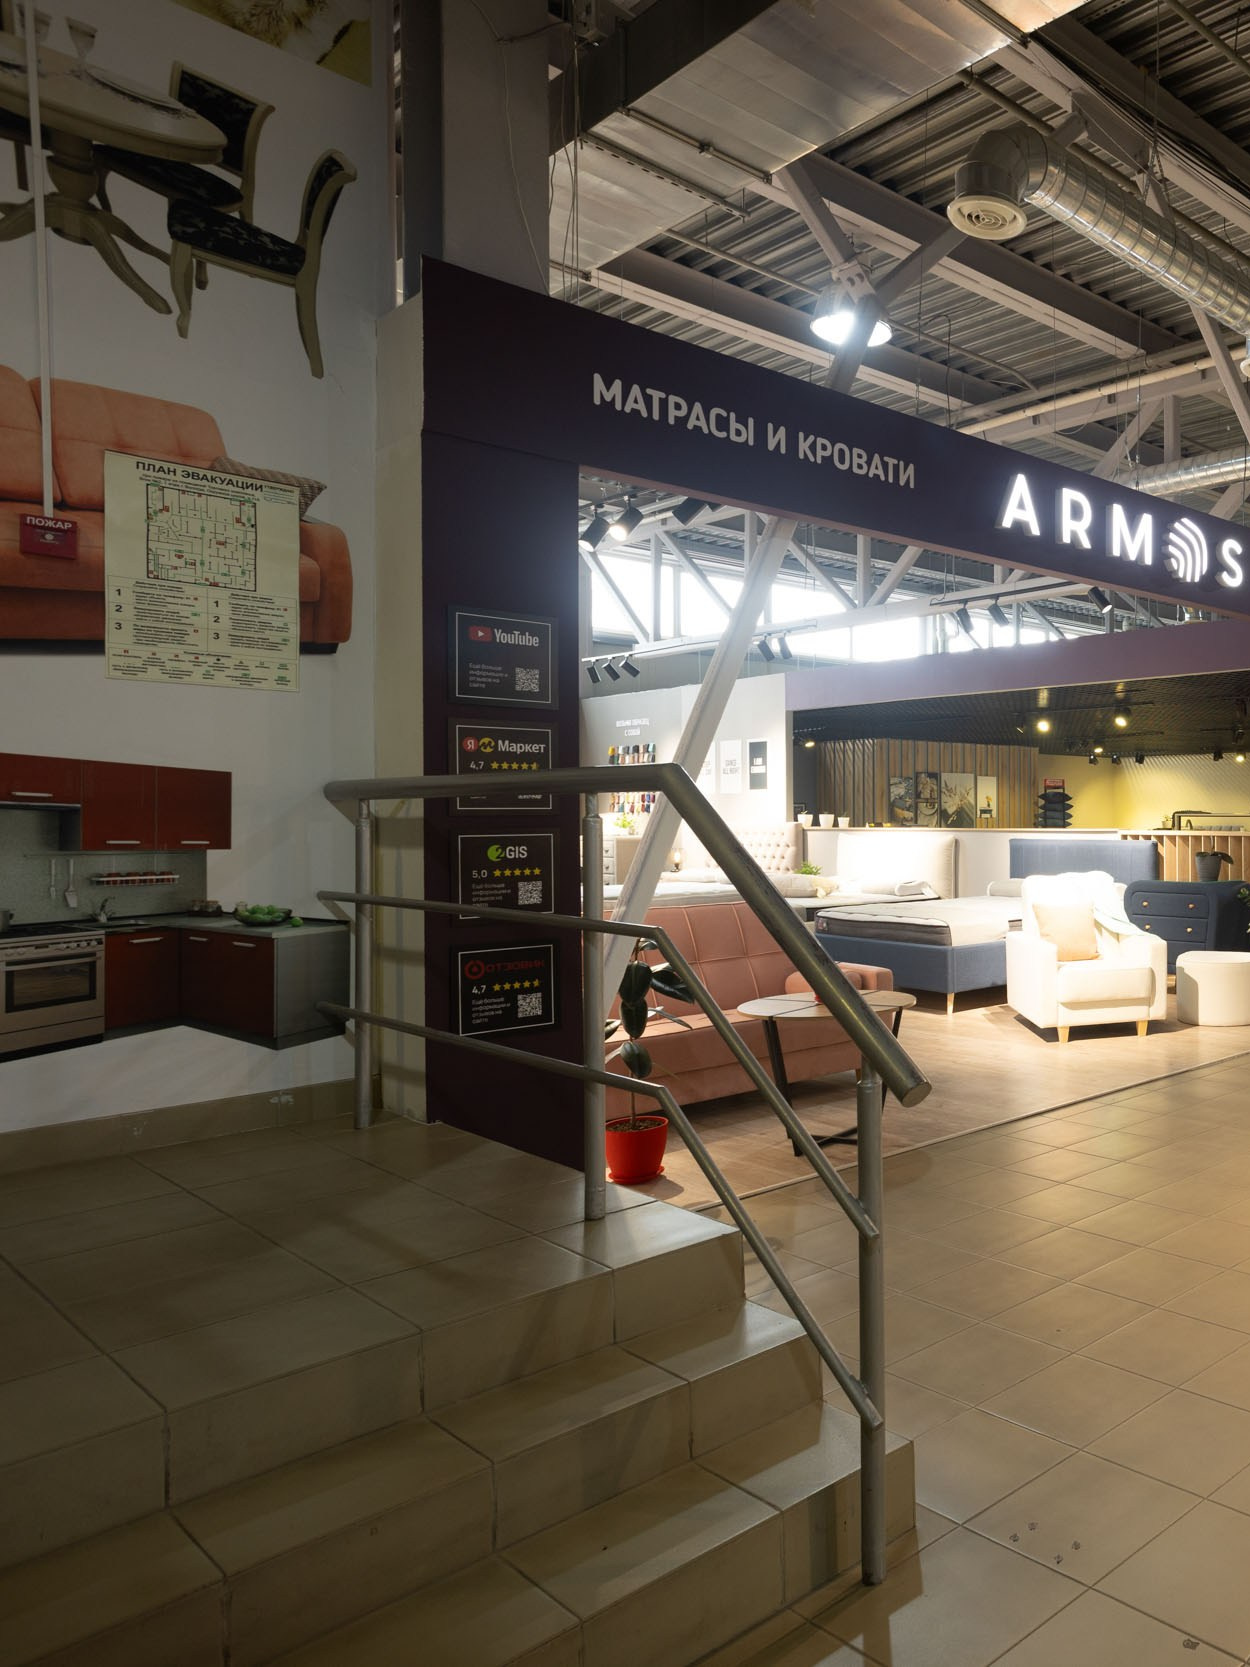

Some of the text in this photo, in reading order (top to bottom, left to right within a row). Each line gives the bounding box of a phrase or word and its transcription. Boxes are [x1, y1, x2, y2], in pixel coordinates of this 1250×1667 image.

[593, 373, 915, 489] МАТРАСЫ И КРОВАТИ
[135, 461, 177, 478] ПЛАН
[181, 469, 264, 493] ЭВАКУАЦИИ
[26, 516, 73, 530] ПОЖАР
[115, 588, 122, 596] 1
[115, 605, 123, 613] 2
[213, 616, 220, 624] 2
[115, 622, 123, 631] 3
[213, 632, 220, 640] 3
[494, 628, 540, 647] YouTube
[497, 739, 546, 754] Маркет
[469, 761, 485, 771] 4,7
[472, 869, 488, 879] 5,0
[472, 984, 486, 995] 4,7
